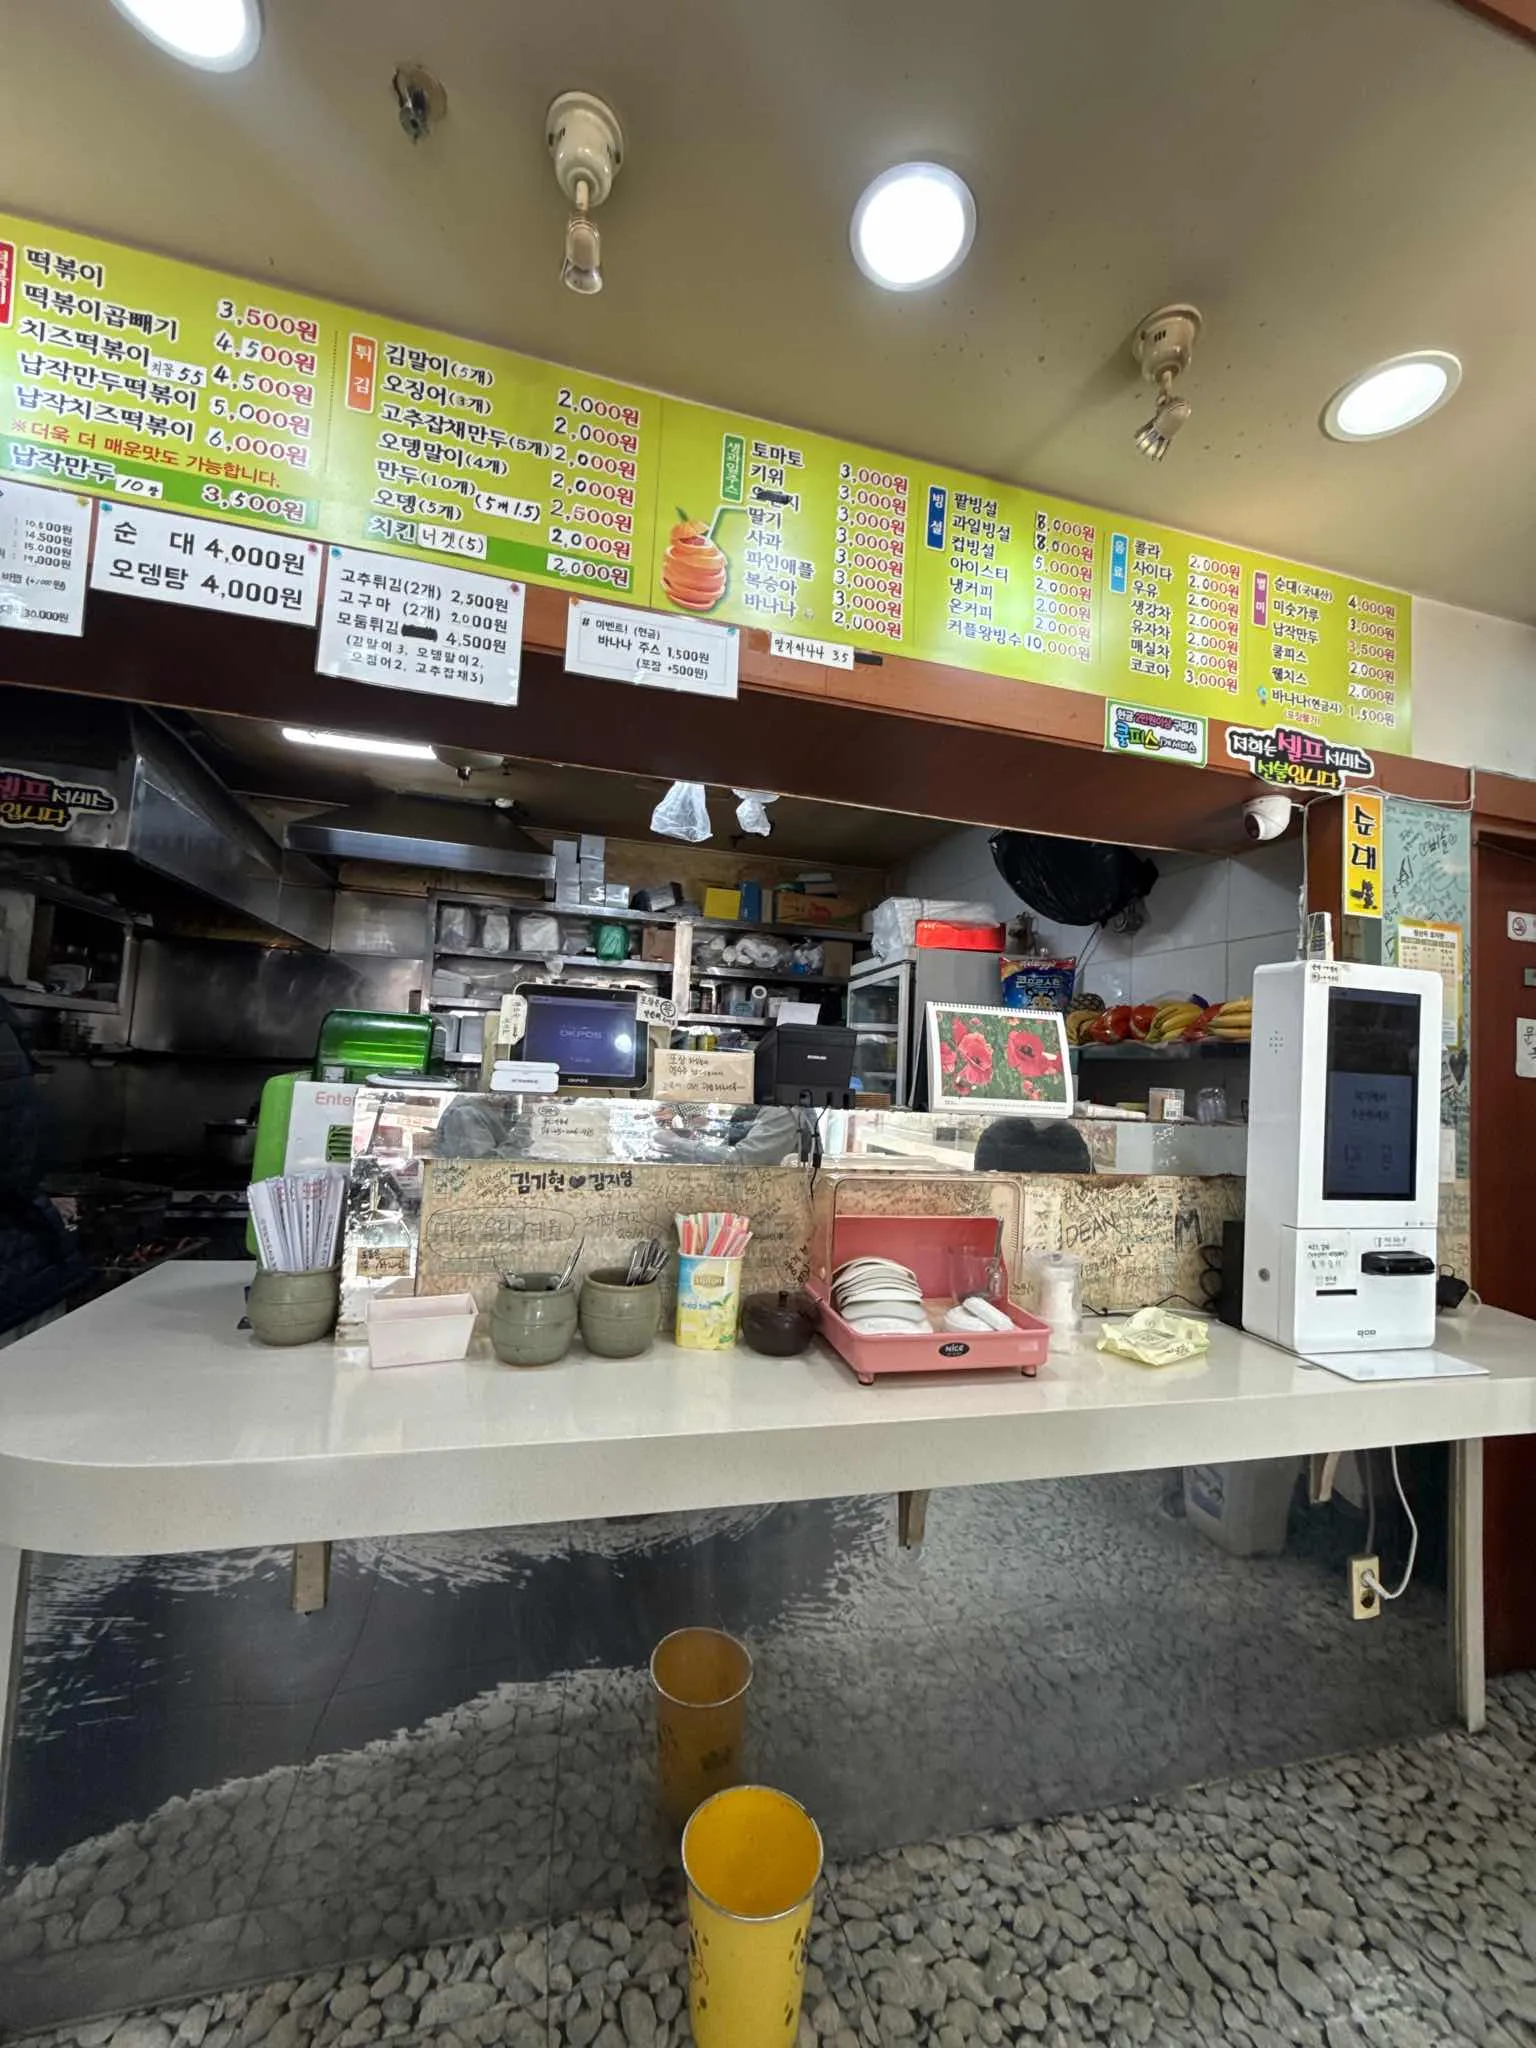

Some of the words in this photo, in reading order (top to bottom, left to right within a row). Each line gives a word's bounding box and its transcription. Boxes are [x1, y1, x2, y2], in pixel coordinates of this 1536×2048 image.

[26, 248, 103, 288] 떡볶이
[24, 284, 177, 341] 떡볶이곱빼기
[218, 301, 318, 344] 3,500원
[20, 319, 149, 368] 치즈떡볶이
[216, 333, 316, 374] 4,500원
[20, 352, 197, 410] 납작만두떡볶이
[214, 365, 313, 406] 4,500원
[385, 343, 494, 386] 김말이(5개)
[558, 389, 639, 425] 2,000원
[16, 386, 193, 442] 납작치즈떡볶이
[212, 398, 310, 437] 5,000원
[78, 430, 96, 448] 더
[103, 436, 179, 466] 매운맛도
[208, 430, 307, 467] 6,000원
[380, 403, 549, 457] 고추잡채만두(5개)
[553, 446, 636, 479] 2,000원
[554, 416, 637, 453] 2,000원
[12, 445, 115, 482] 납작만두
[203, 486, 305, 523] 3,500원
[186, 455, 280, 488] 가능합니다.
[379, 433, 508, 476] 오뎅말이(4개)
[551, 473, 635, 506] 2,000원
[751, 442, 804, 467] 토마토
[840, 463, 907, 494] 3,000원
[376, 460, 475, 496] 만두(10개)
[550, 499, 632, 533] 2,500원
[751, 464, 784, 487] 키위
[839, 485, 906, 516] 3,000원
[954, 493, 997, 518] 팥빙설
[369, 516, 415, 542] 치킨
[374, 489, 464, 521] 오뎅(5개)
[551, 527, 630, 561] 2,000원
[748, 507, 781, 529] 딸기
[836, 527, 904, 556] 3,000원
[838, 507, 905, 536] 3,000원
[952, 515, 1010, 542] 과일빙설
[205, 539, 304, 576] 4,000원
[747, 531, 782, 550] 사과
[836, 549, 904, 577] 3,000원
[1134, 540, 1160, 559] 콜라
[109, 559, 189, 591] 오뎅탕
[201, 575, 302, 611] 4,000원
[745, 550, 814, 580] 파인애플
[834, 570, 903, 598] 3,000원
[950, 557, 1008, 583] 아이스티
[950, 577, 993, 600] 냉커피
[1132, 561, 1172, 582] 사이다
[744, 593, 796, 617] 바나나
[745, 572, 797, 596] 복숭아
[833, 591, 902, 618] 3,000원
[1132, 580, 1158, 599] 우유
[337, 611, 399, 636] 모둠튀김
[948, 598, 992, 620] 온커피
[1131, 600, 1171, 621] 생강차
[598, 635, 632, 651] 바나나
[639, 642, 661, 656] 주스
[1131, 619, 1170, 640] 유자차
[1273, 622, 1319, 645] 납작만두
[1131, 639, 1170, 659] 매실차
[1131, 658, 1170, 679] 코코아
[1232, 735, 1277, 757] 저희는
[1278, 731, 1324, 763] 셀프
[1325, 749, 1369, 771] 서비스
[1352, 805, 1377, 870] 순대
[510, 1169, 565, 1195] 김기현
[589, 1170, 633, 1191] 김지영
